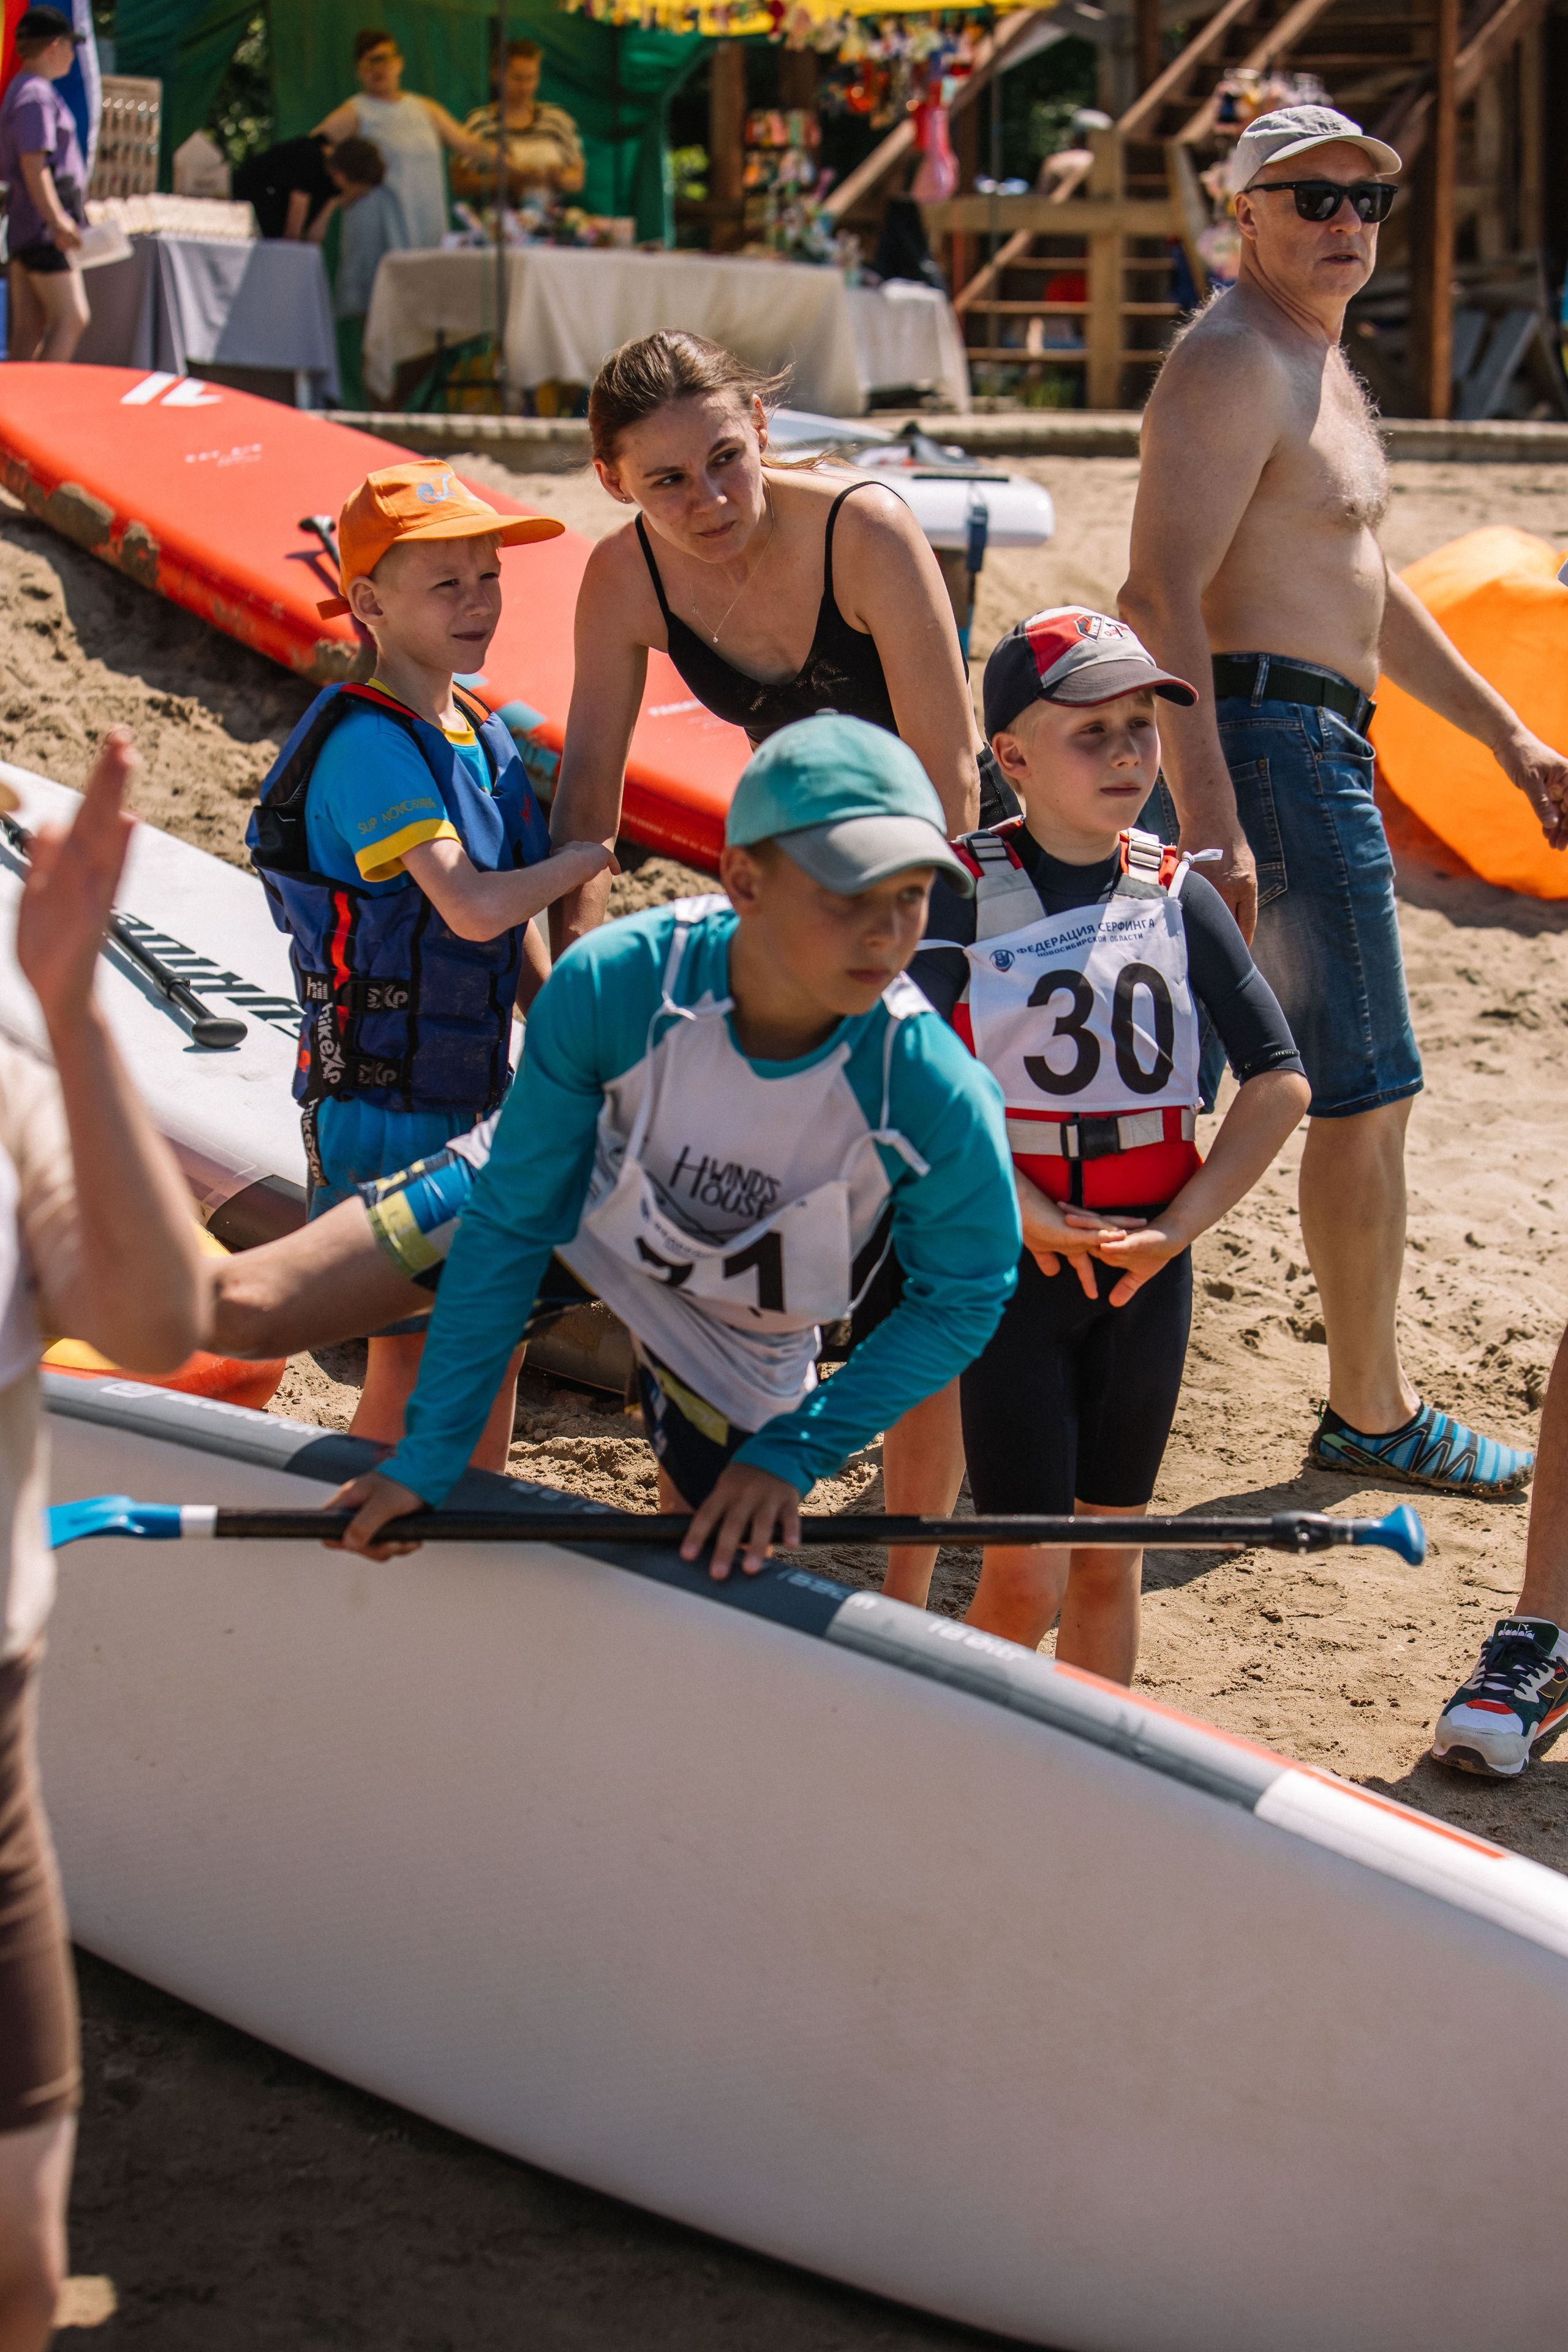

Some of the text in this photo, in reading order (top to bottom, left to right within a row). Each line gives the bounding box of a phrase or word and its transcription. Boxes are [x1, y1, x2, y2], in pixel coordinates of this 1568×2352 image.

[1017, 918, 1155, 954] ФЕДЕРАЦИЯ СЕРФИНГА
[1109, 933, 1144, 942] ОБЛАСТИ
[1023, 963, 1175, 1096] 30
[1498, 1622, 1535, 1640] diadora
